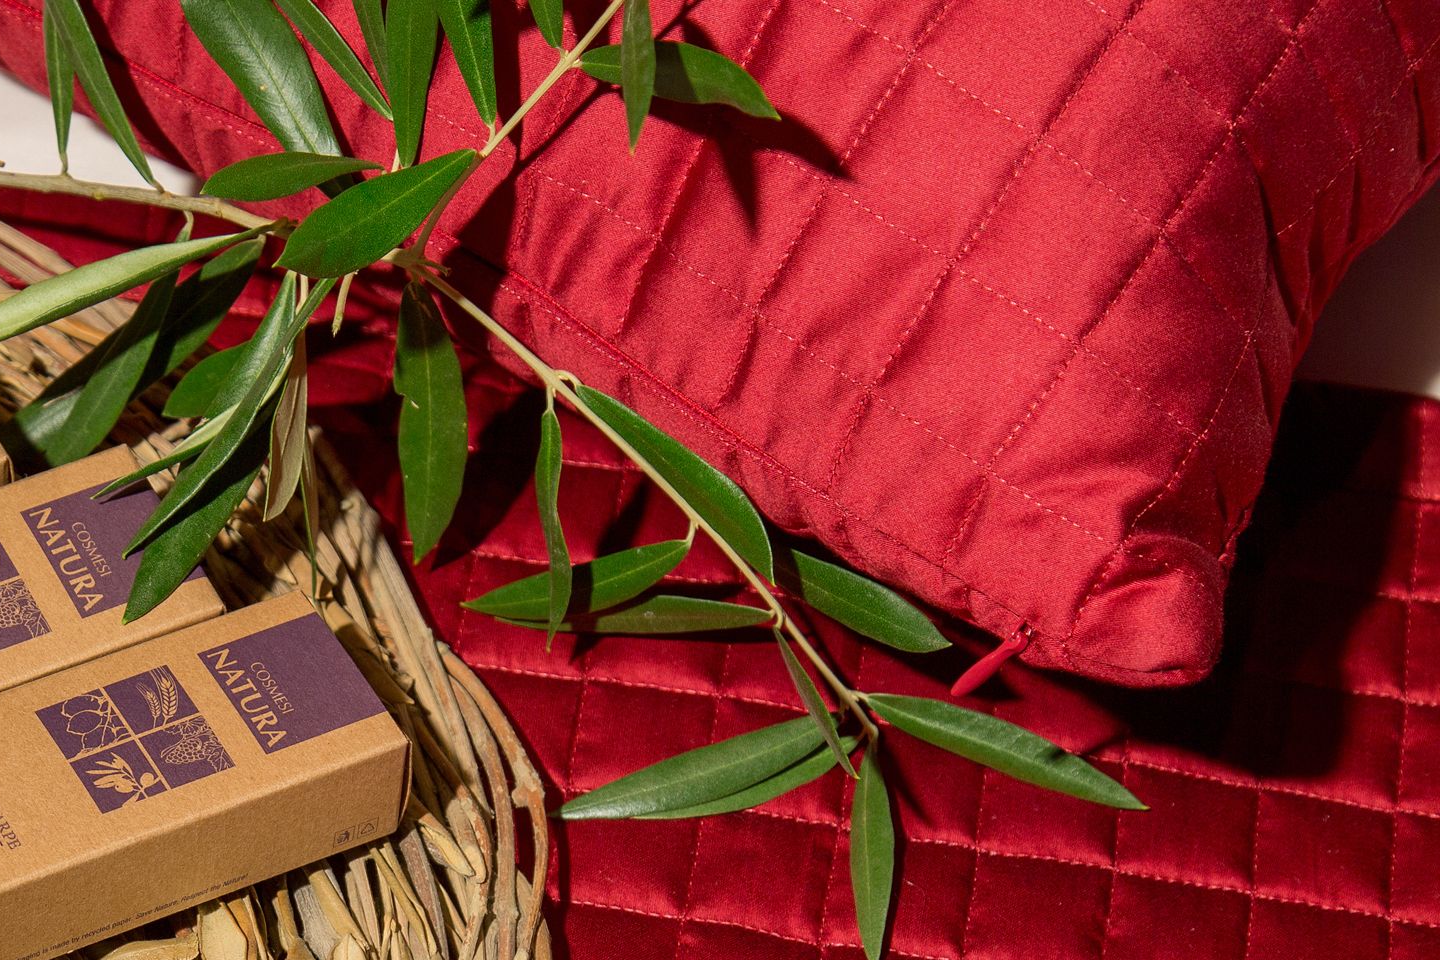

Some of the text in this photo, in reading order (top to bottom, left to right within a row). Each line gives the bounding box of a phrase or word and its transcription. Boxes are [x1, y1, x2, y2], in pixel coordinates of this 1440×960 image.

[29, 507, 104, 612] NATURA
[71, 521, 113, 577] COSMESI
[207, 648, 287, 748] NATURA
[250, 662, 294, 714] COSMESI
[50, 941, 70, 951] made
[71, 936, 80, 944] by
[81, 925, 111, 940] recycled
